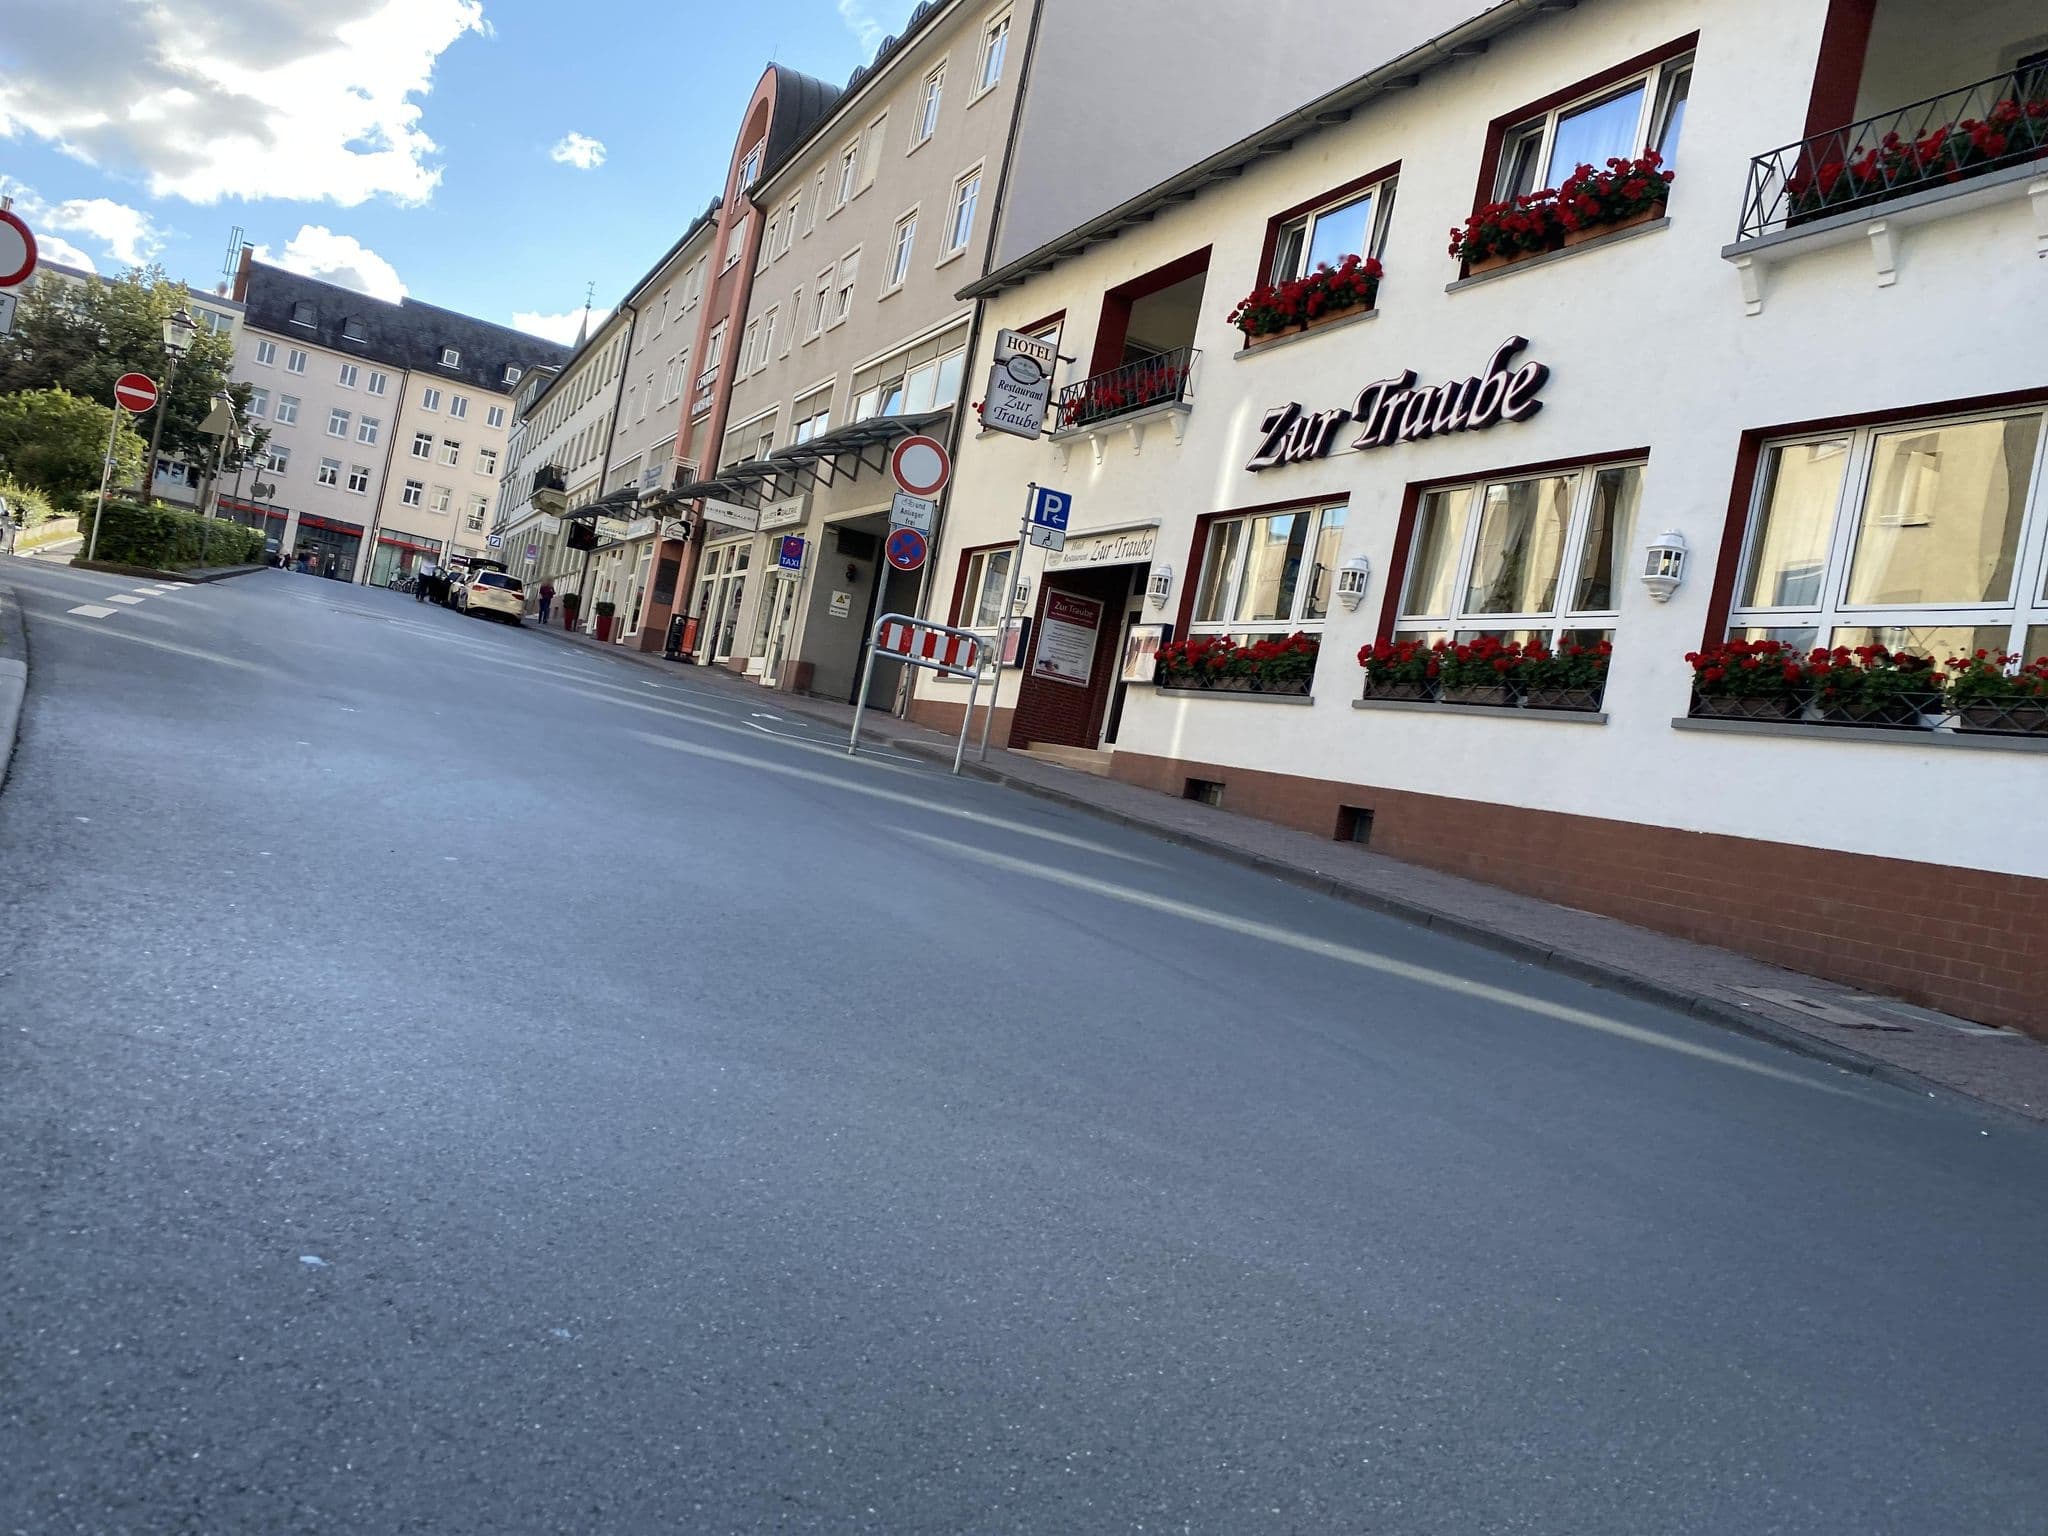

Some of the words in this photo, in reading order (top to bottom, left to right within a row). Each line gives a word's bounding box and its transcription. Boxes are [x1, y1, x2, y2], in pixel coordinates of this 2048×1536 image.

[1007, 336, 1052, 361] HOTEL
[997, 380, 1043, 401] Restaurant
[1004, 395, 1032, 412] Zur
[1246, 402, 1352, 472] Zur
[1351, 335, 1550, 450] Traube
[994, 407, 1039, 430] Traube
[1042, 494, 1063, 522] P
[1090, 540, 1113, 562] Zur
[1114, 530, 1153, 559] Traube
[782, 557, 800, 567] TAXI
[1054, 601, 1068, 611] Zur
[1069, 605, 1094, 618] Traube
